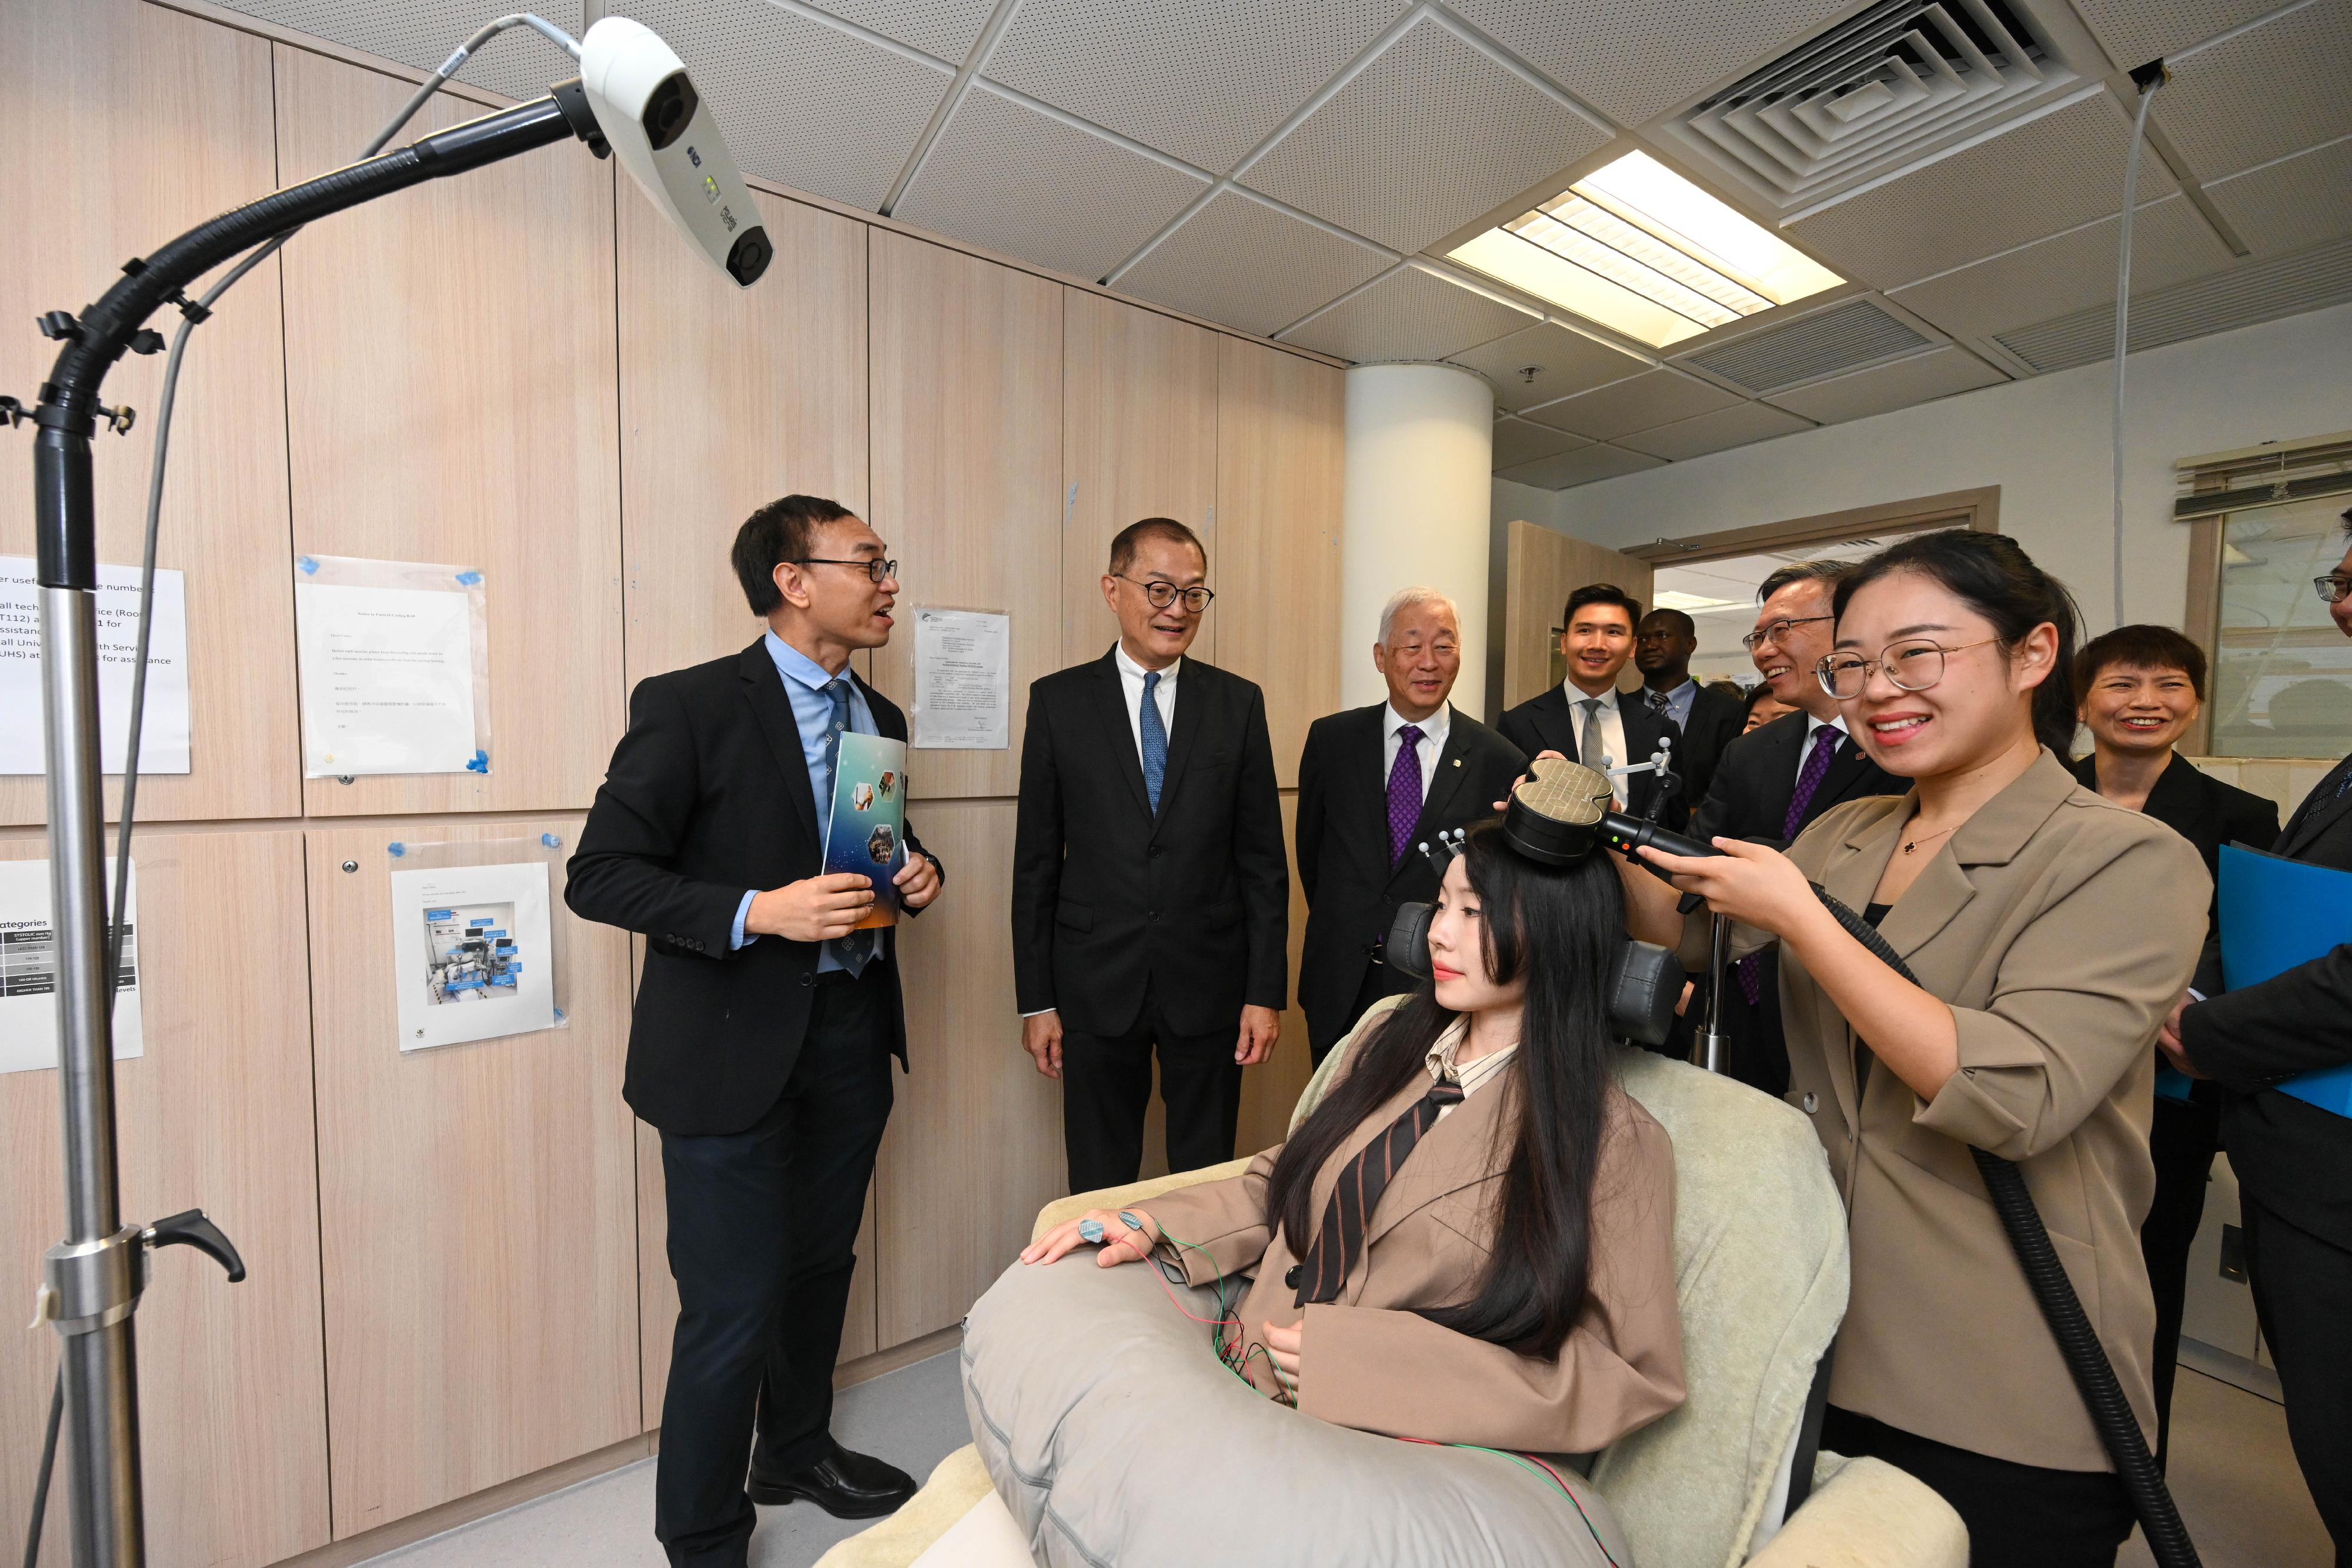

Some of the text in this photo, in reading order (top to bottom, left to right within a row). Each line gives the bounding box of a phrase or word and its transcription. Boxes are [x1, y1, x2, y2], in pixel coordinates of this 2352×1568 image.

[116, 609, 142, 617] (Roo
[0, 614, 30, 623] T112)
[0, 650, 26, 659] UHS)
[0, 919, 47, 930] ategories
